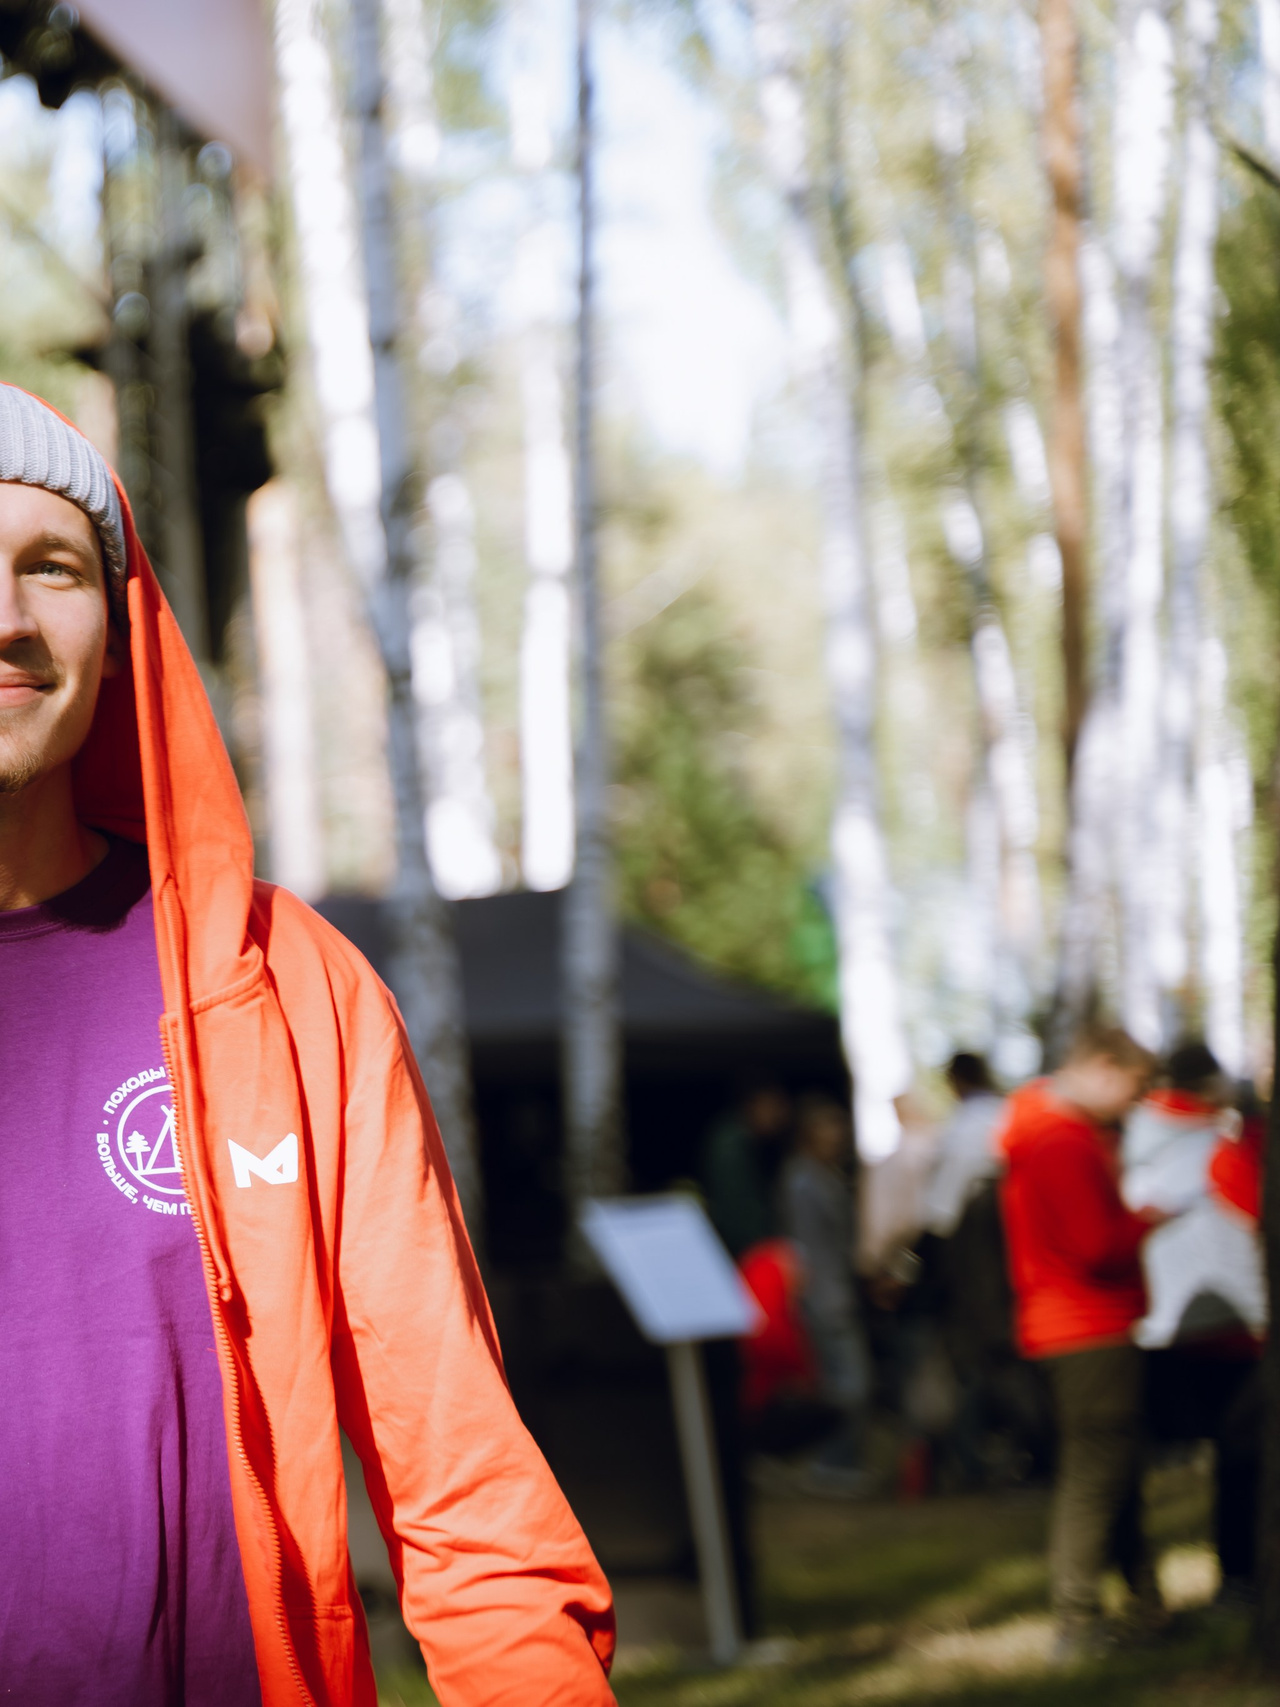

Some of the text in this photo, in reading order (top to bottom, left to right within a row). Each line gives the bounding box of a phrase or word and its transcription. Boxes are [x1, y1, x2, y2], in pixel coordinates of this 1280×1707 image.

[102, 1066, 167, 1115] ПОХОДЫ
[96, 1132, 139, 1204] БОЛЬШЕ,
[142, 1194, 178, 1216] ЧЕМ
